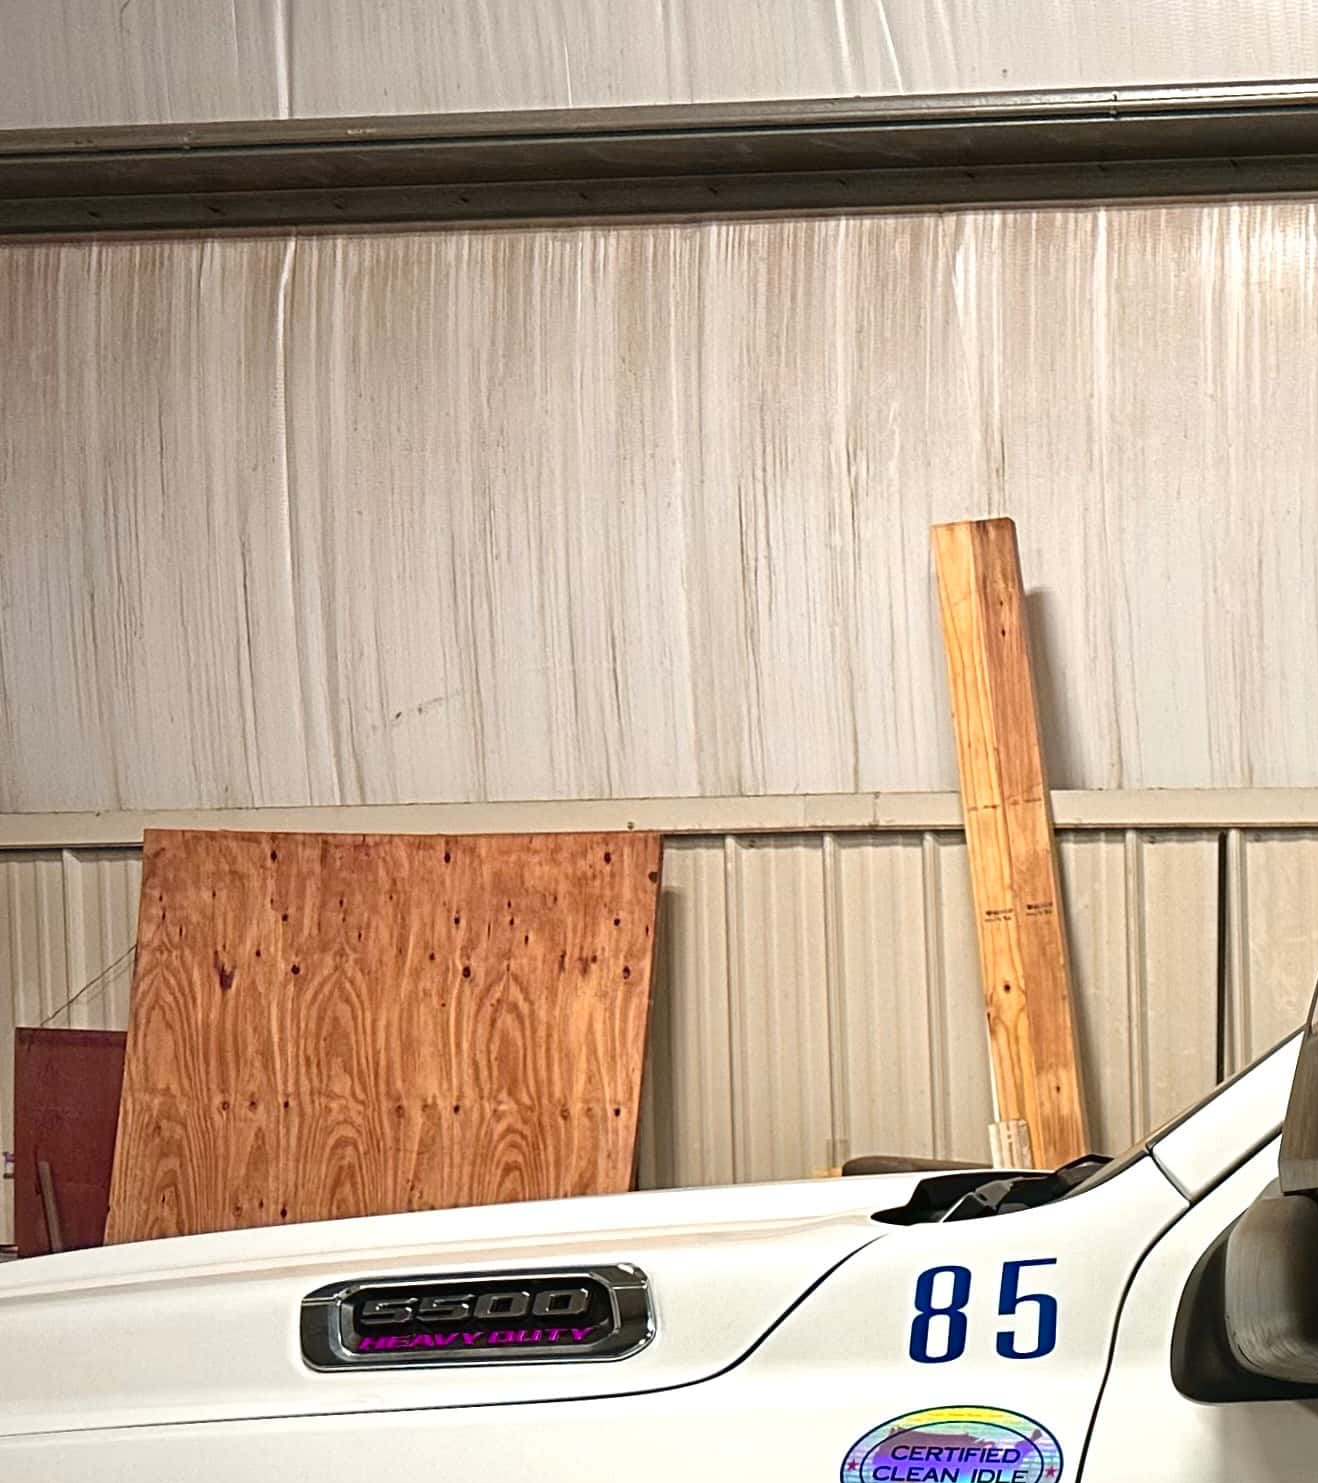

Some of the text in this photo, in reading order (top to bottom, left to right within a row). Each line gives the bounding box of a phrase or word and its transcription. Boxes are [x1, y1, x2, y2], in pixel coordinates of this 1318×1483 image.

[359, 1287, 590, 1326] 5500
[909, 1258, 1058, 1364] 85
[359, 1327, 593, 1352] HEAVY DUTY
[890, 1444, 1021, 1464] CERTIFIED
[872, 1466, 959, 1483] CLEAN
